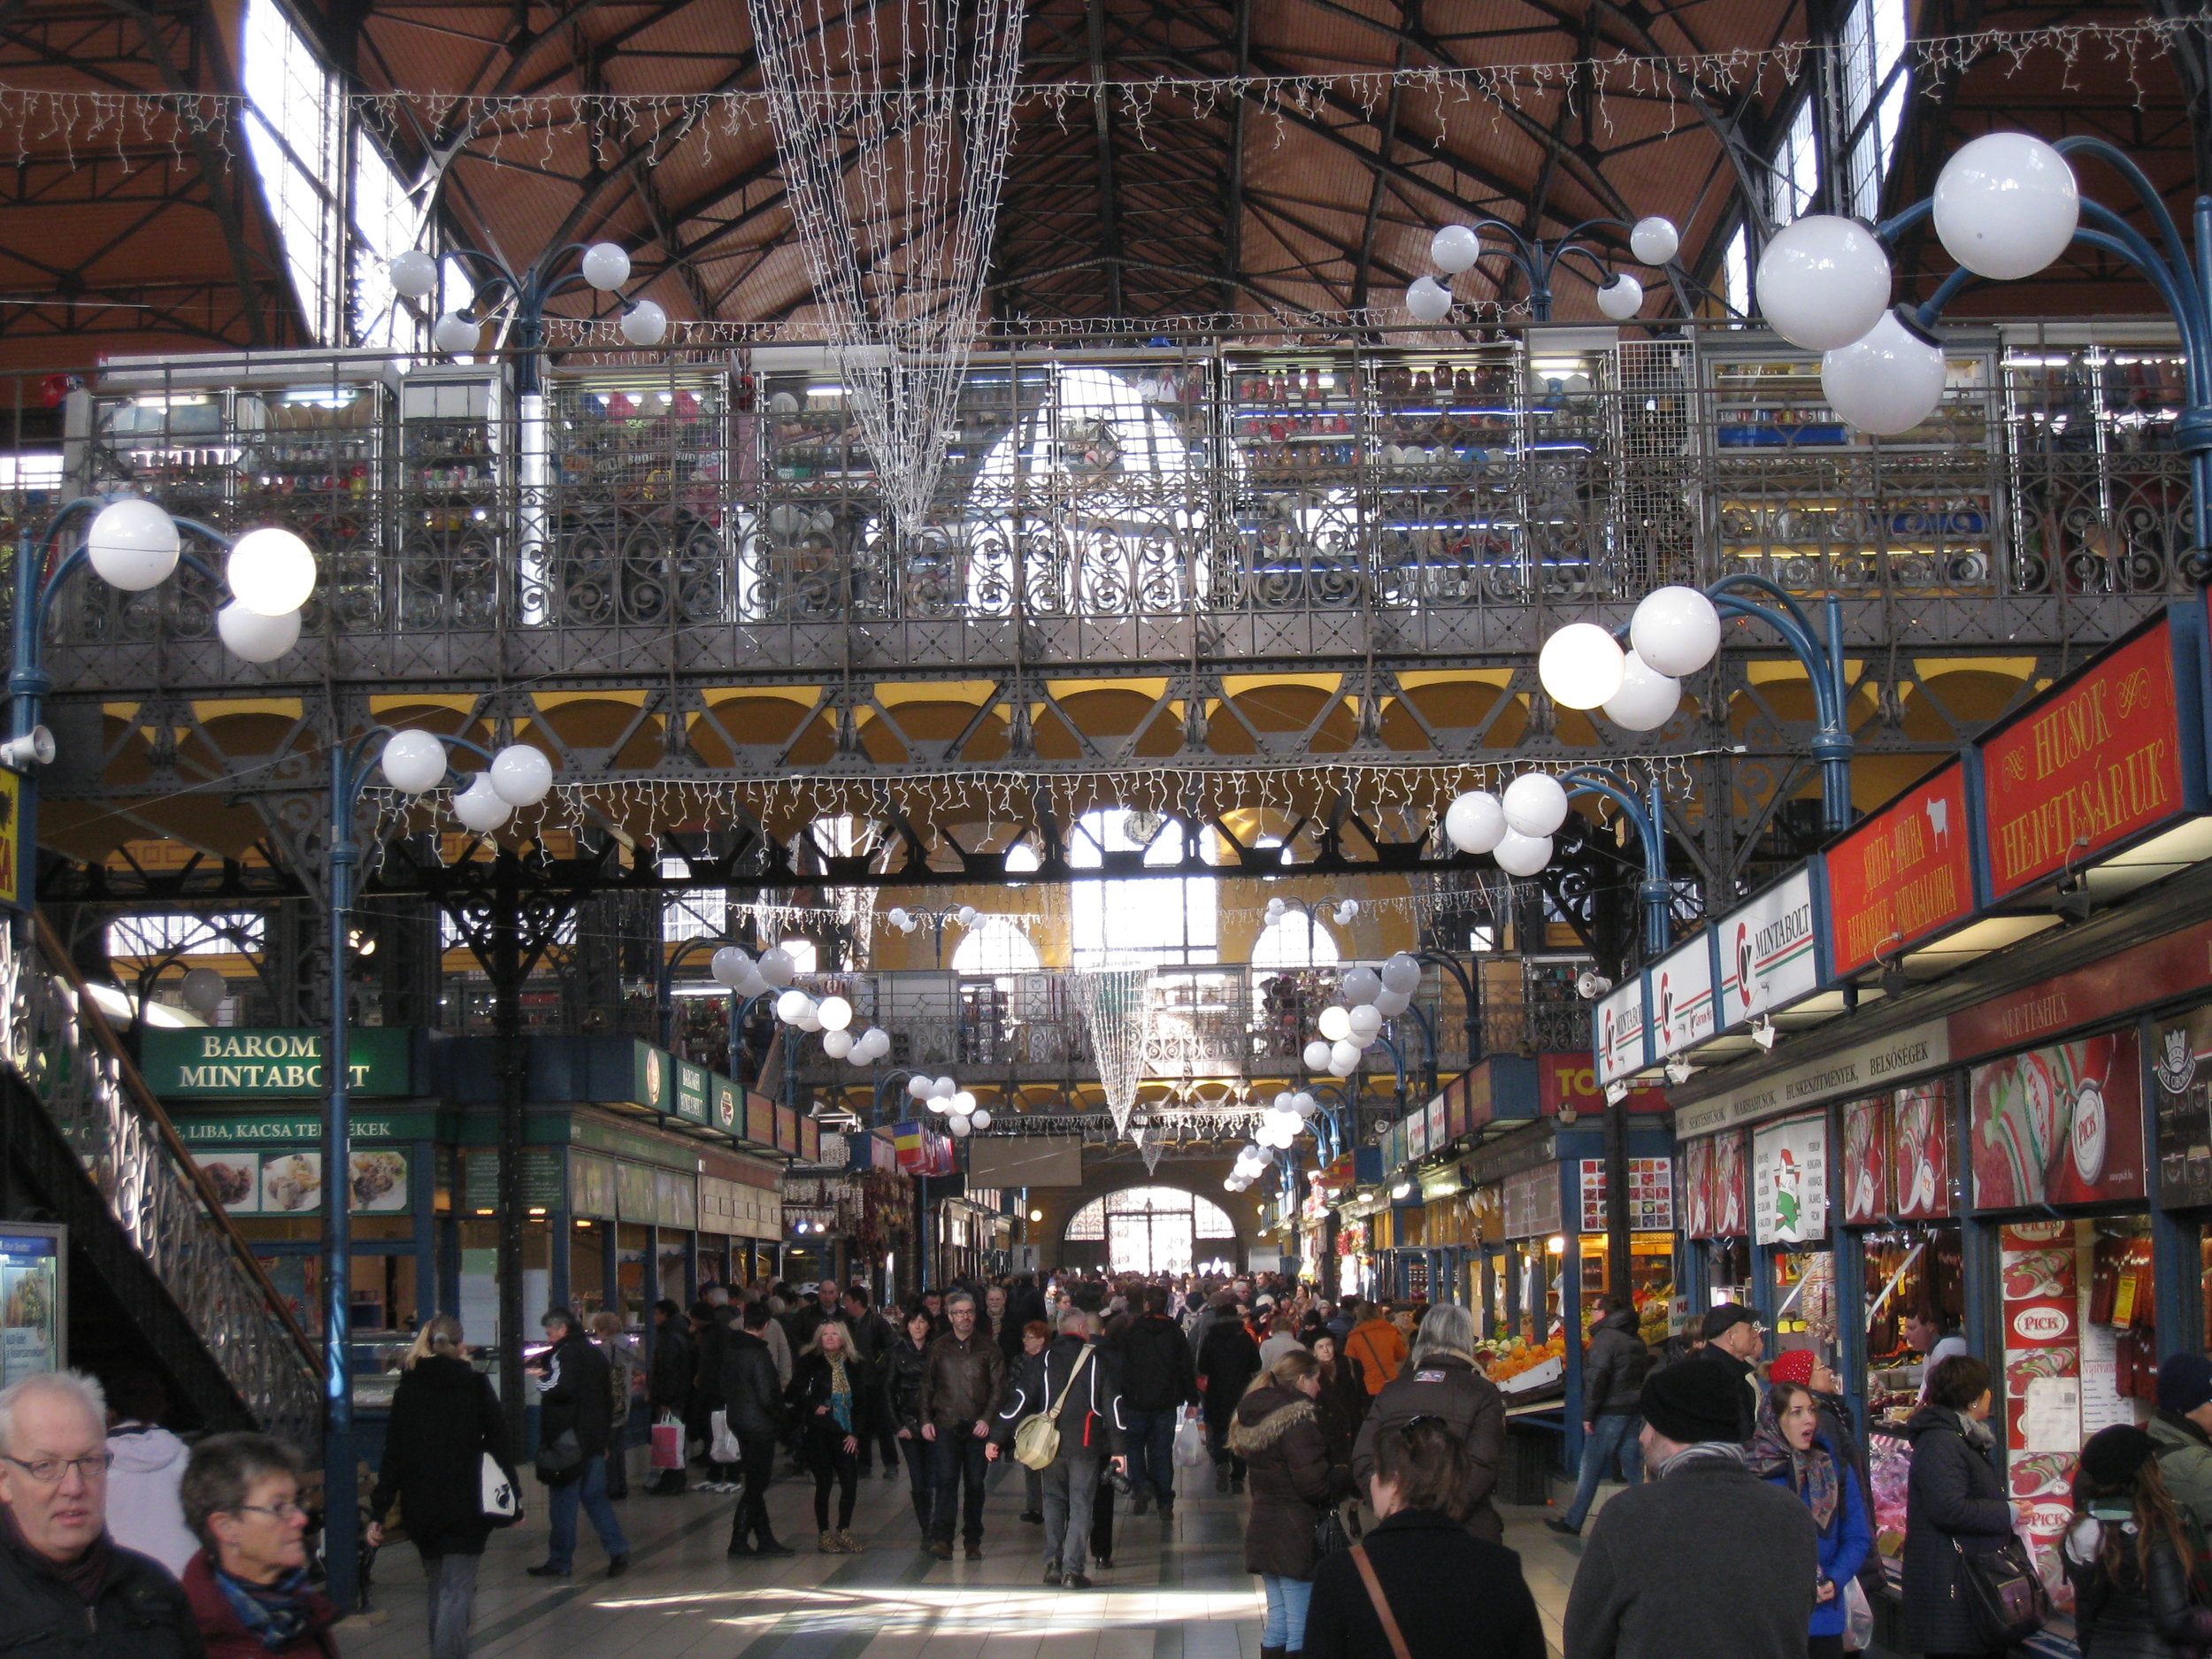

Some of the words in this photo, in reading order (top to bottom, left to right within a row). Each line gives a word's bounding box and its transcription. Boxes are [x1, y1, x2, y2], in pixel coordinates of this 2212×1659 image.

[2001, 738, 2168, 880] HENTESÁRUK
[1755, 902, 1810, 960] MINTABOLT
[1616, 1002, 1643, 1036] MINTABOL
[202, 1035, 321, 1058] BAROM
[179, 1065, 371, 1088] MINTABOT
[189, 1125, 233, 1140] LIBA,
[235, 1124, 292, 1139] KACSA
[295, 1120, 391, 1138] TEÉKEK
[2078, 1110, 2097, 1148] PICK
[2021, 1221, 2055, 1233] PICK
[2024, 1316, 2059, 1332] PICK
[2032, 1512, 2064, 1526] PICK
